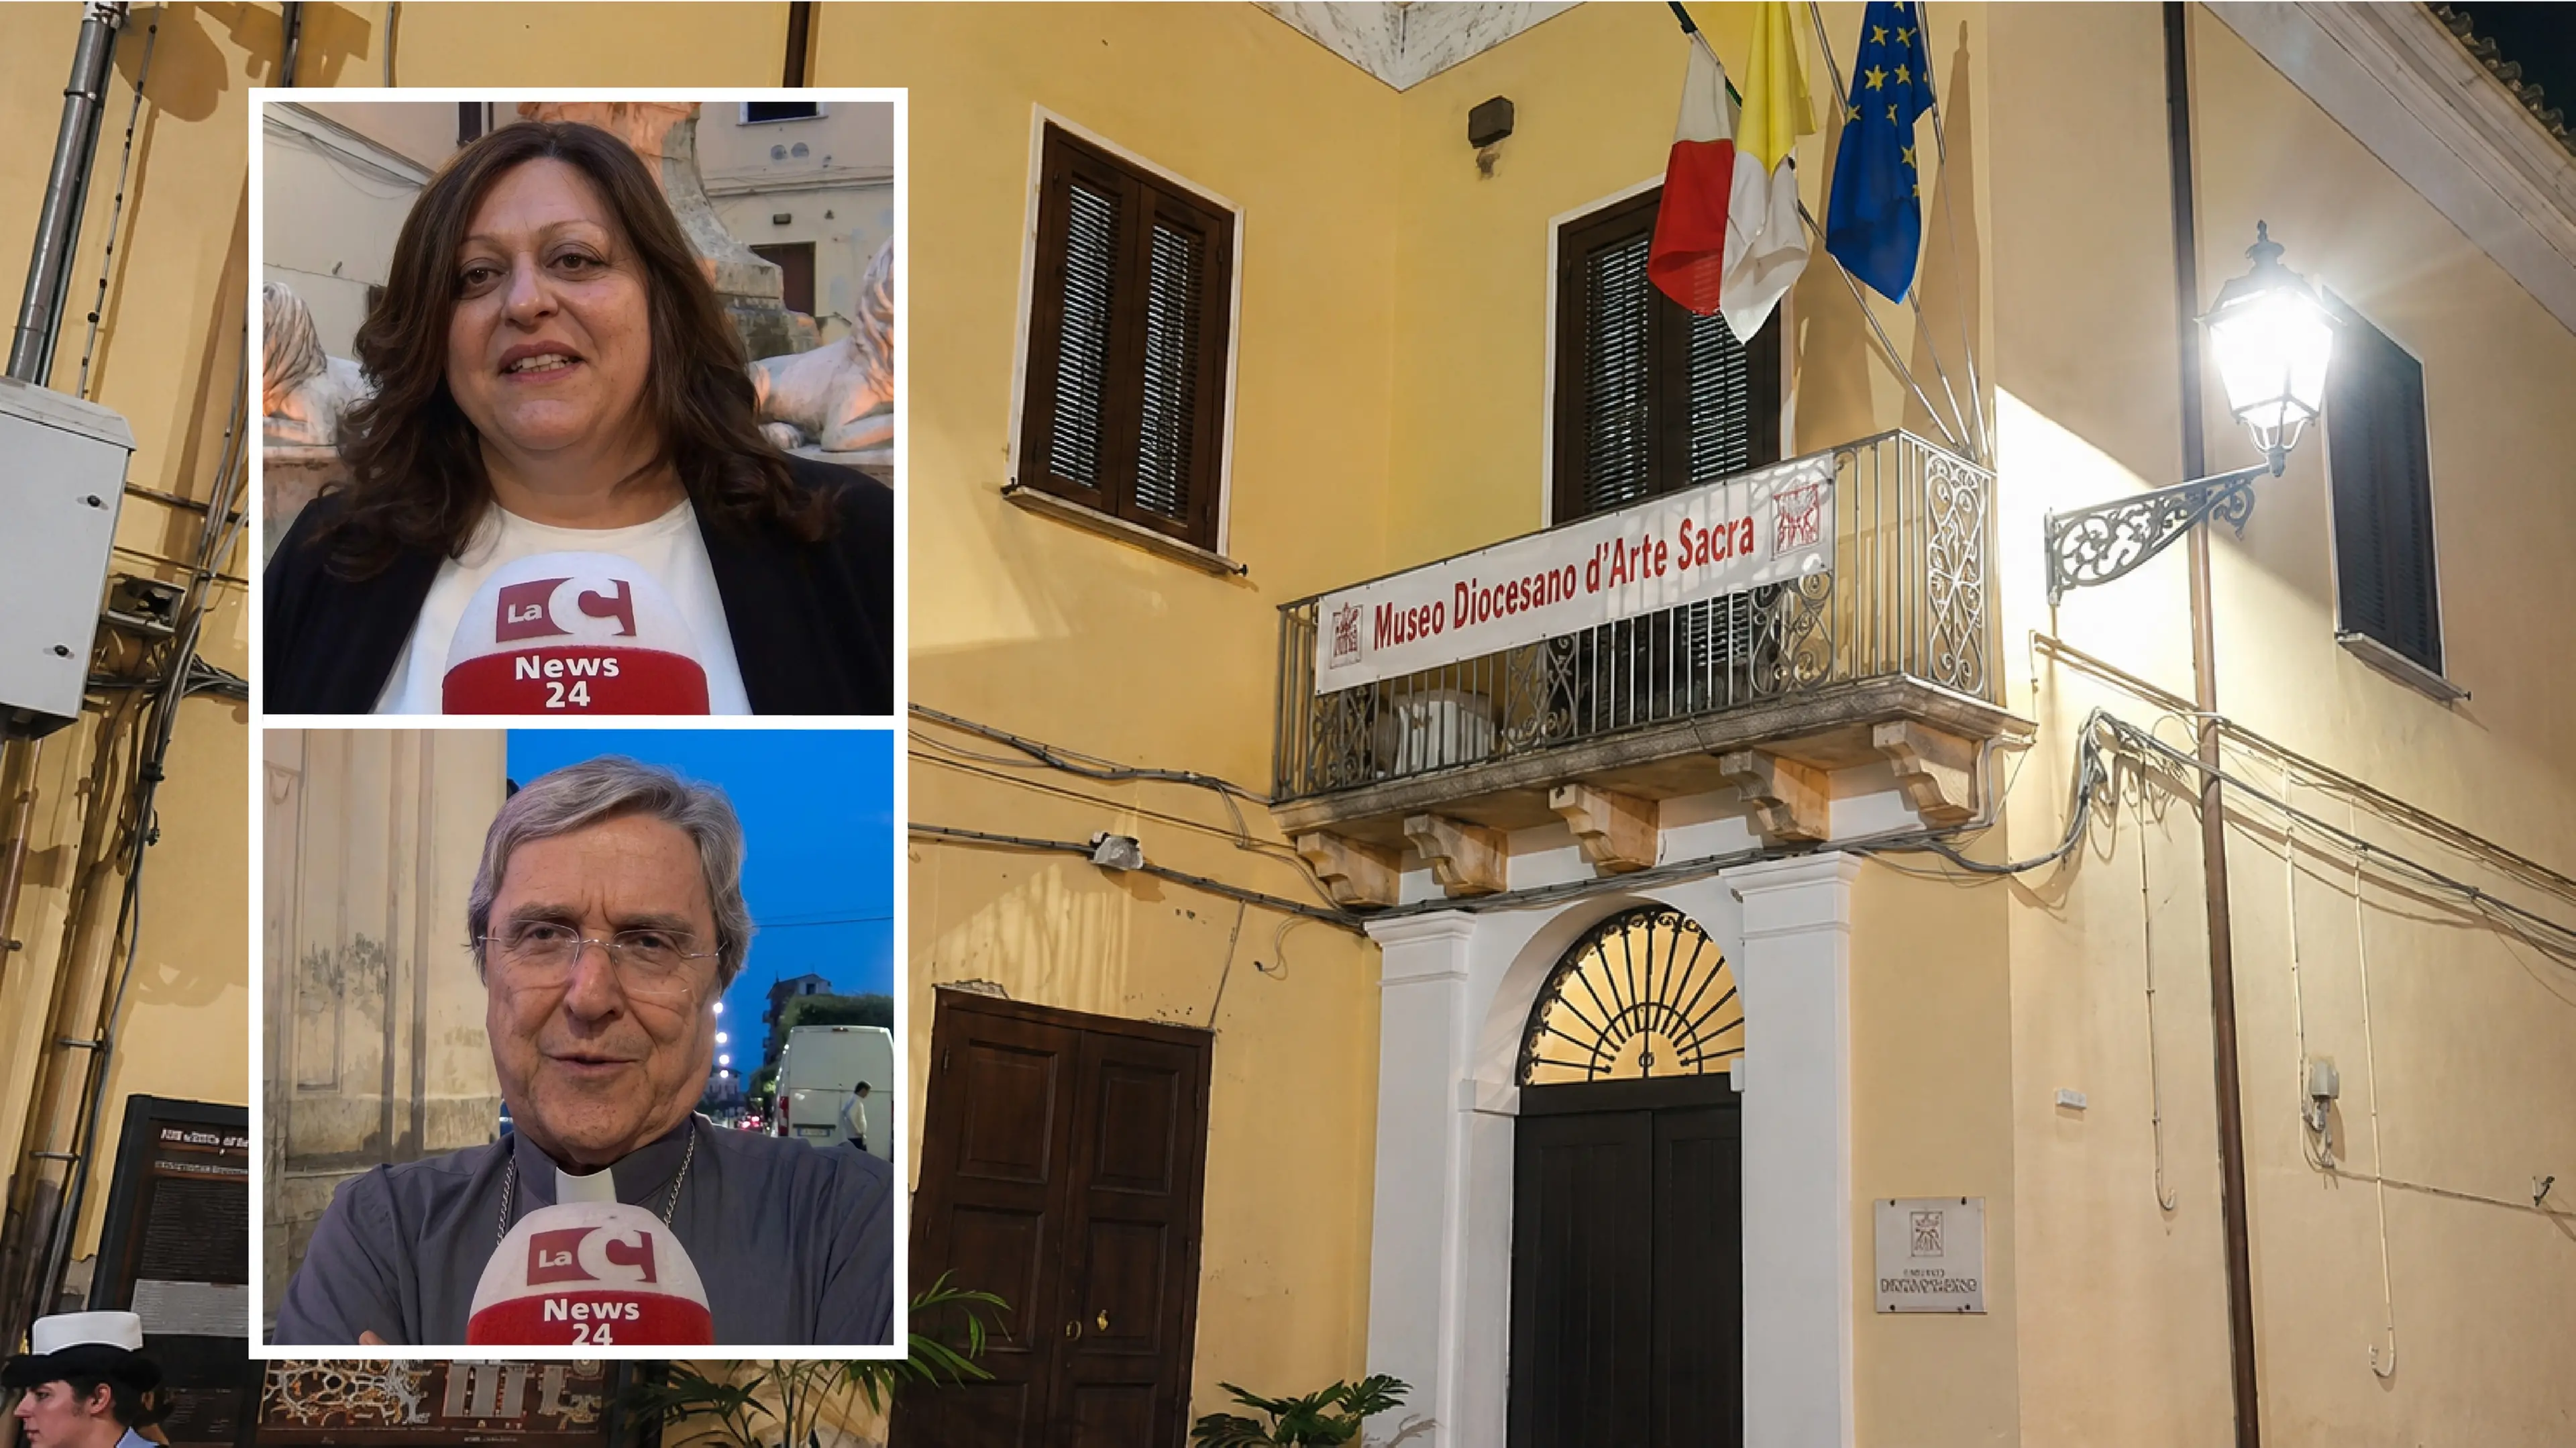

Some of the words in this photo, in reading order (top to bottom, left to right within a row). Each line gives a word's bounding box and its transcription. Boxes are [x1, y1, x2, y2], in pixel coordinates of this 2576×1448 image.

[1373, 600, 1445, 651] Museo
[1452, 564, 1576, 629] Diocesano
[1677, 516, 1755, 570] Sacra
[515, 655, 620, 680] News
[545, 680, 591, 708] 24
[543, 1298, 641, 1322] News
[572, 1323, 613, 1345] 24
